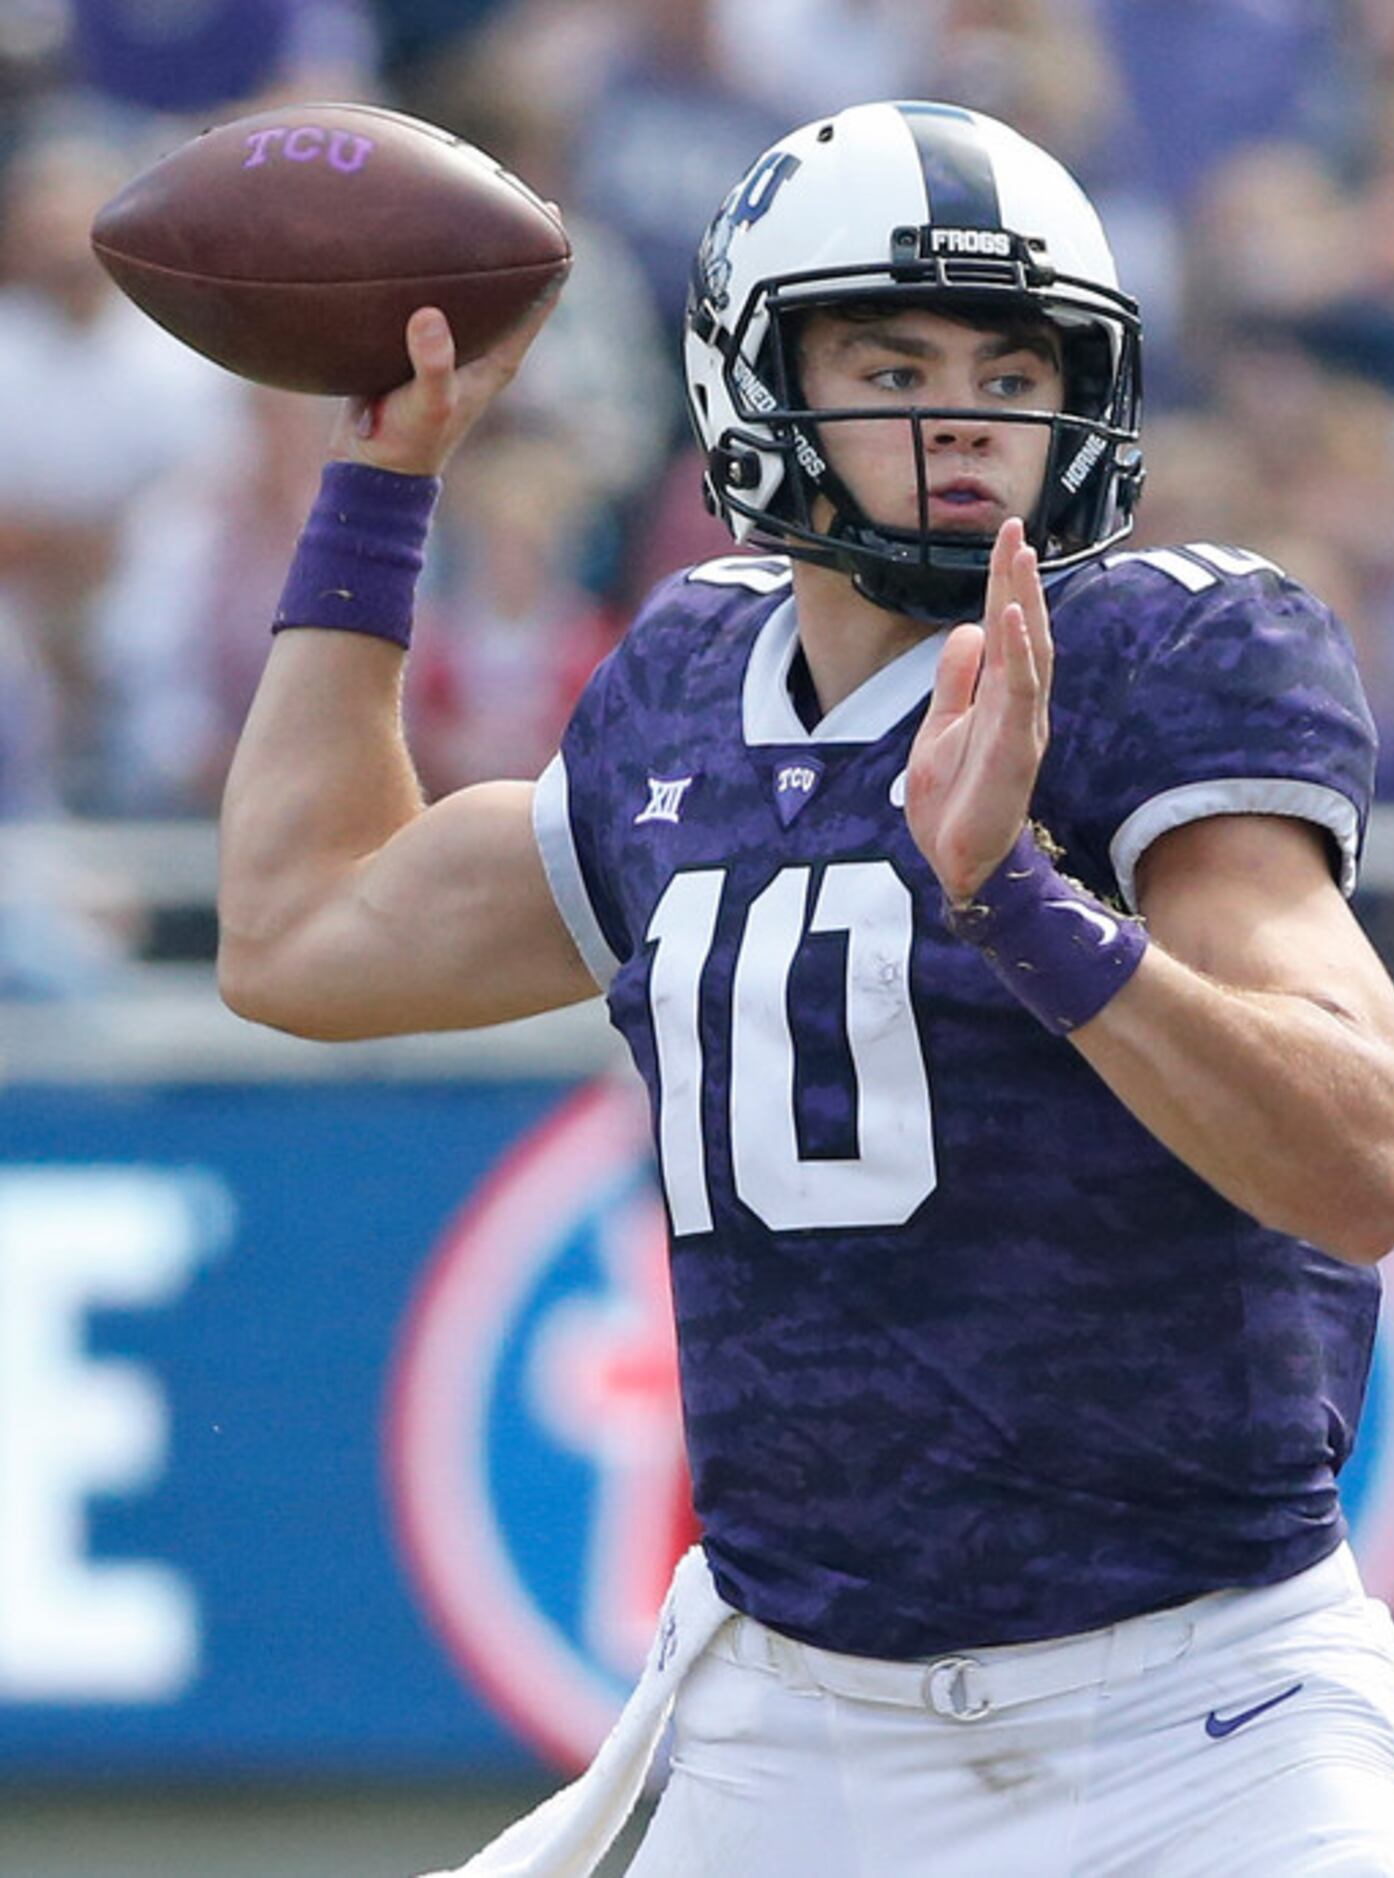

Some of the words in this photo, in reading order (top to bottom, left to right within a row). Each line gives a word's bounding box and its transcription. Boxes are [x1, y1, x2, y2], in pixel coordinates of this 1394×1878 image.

[242, 126, 376, 173] TCU
[931, 229, 1010, 256] FROGS
[778, 767, 816, 792] TCU
[645, 860, 938, 1236] 10
